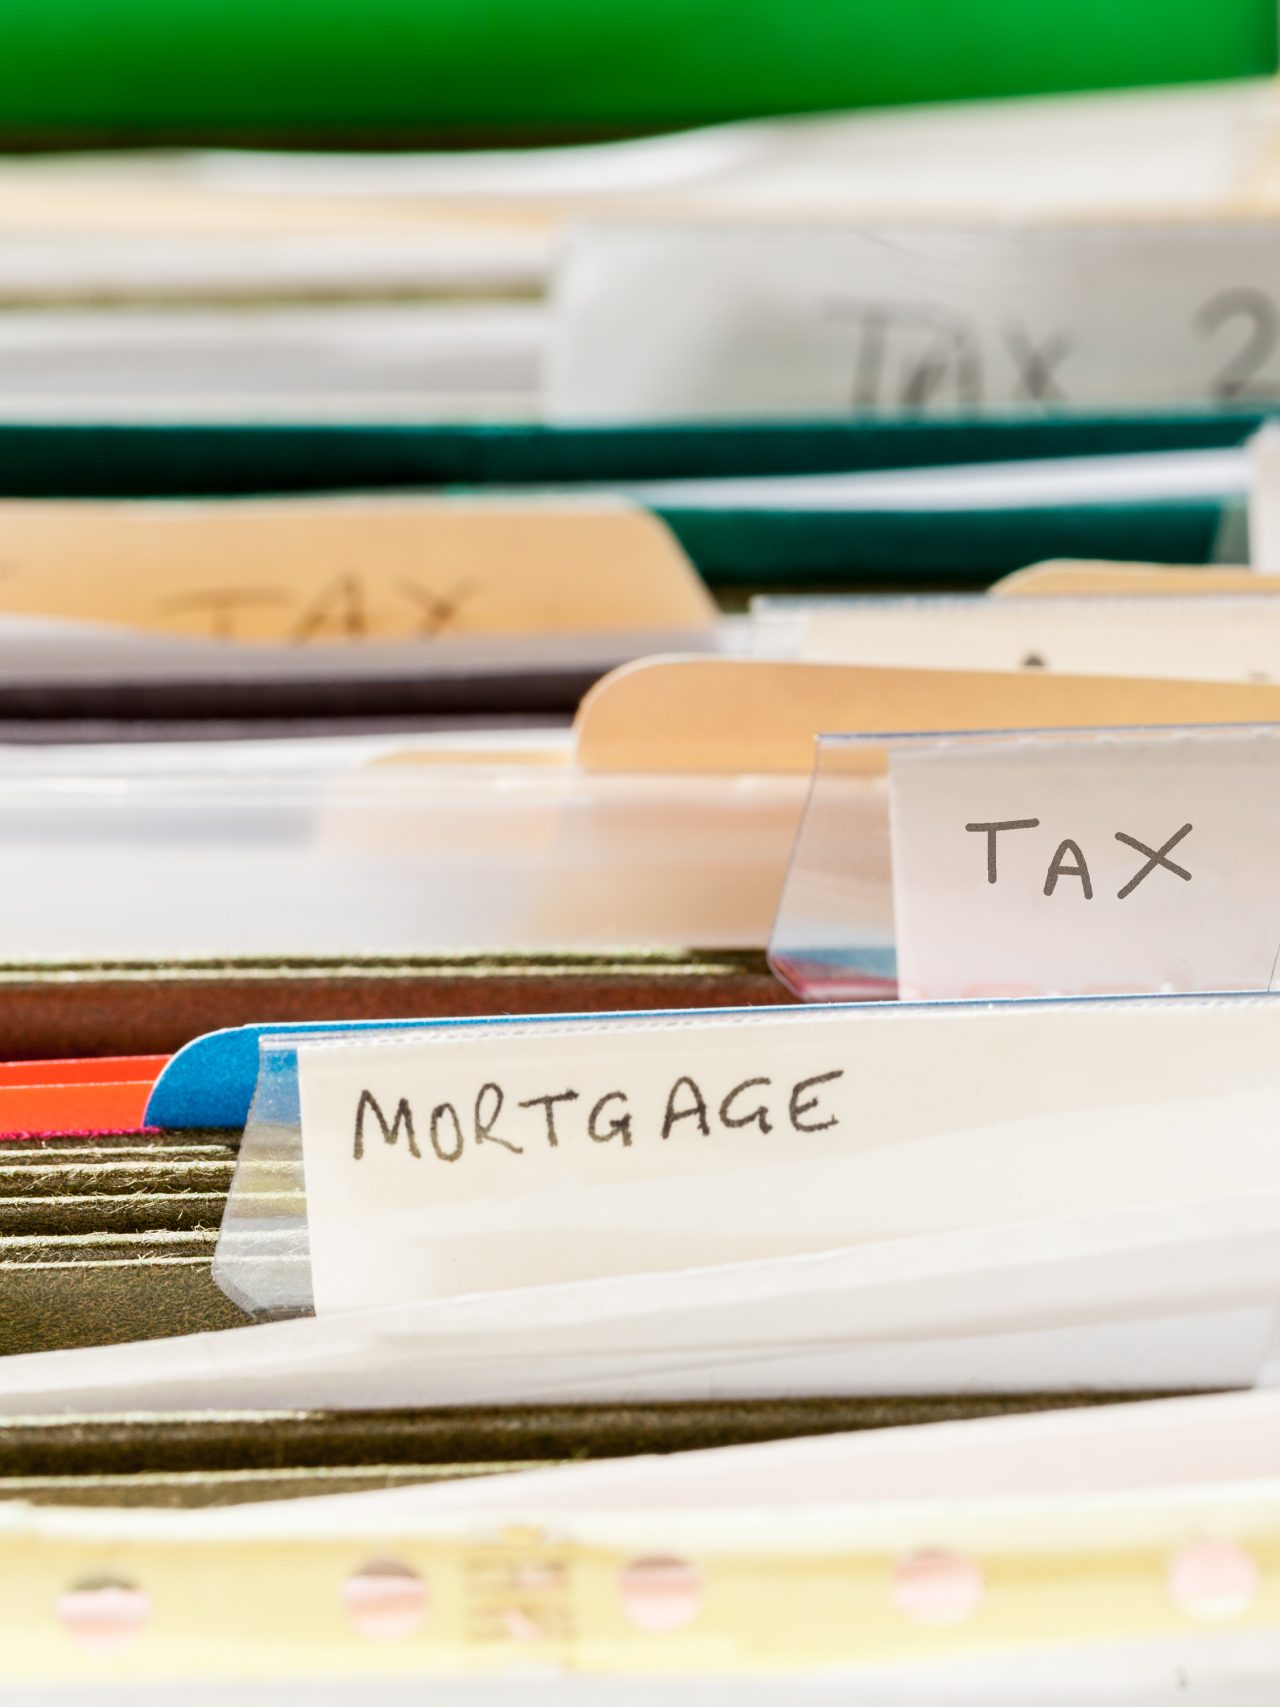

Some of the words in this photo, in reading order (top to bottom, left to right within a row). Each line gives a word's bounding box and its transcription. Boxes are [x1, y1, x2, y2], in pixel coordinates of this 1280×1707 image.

[156, 566, 484, 648] TAX
[965, 818, 1193, 900] TAX
[352, 1069, 845, 1162] MORTGAGE
